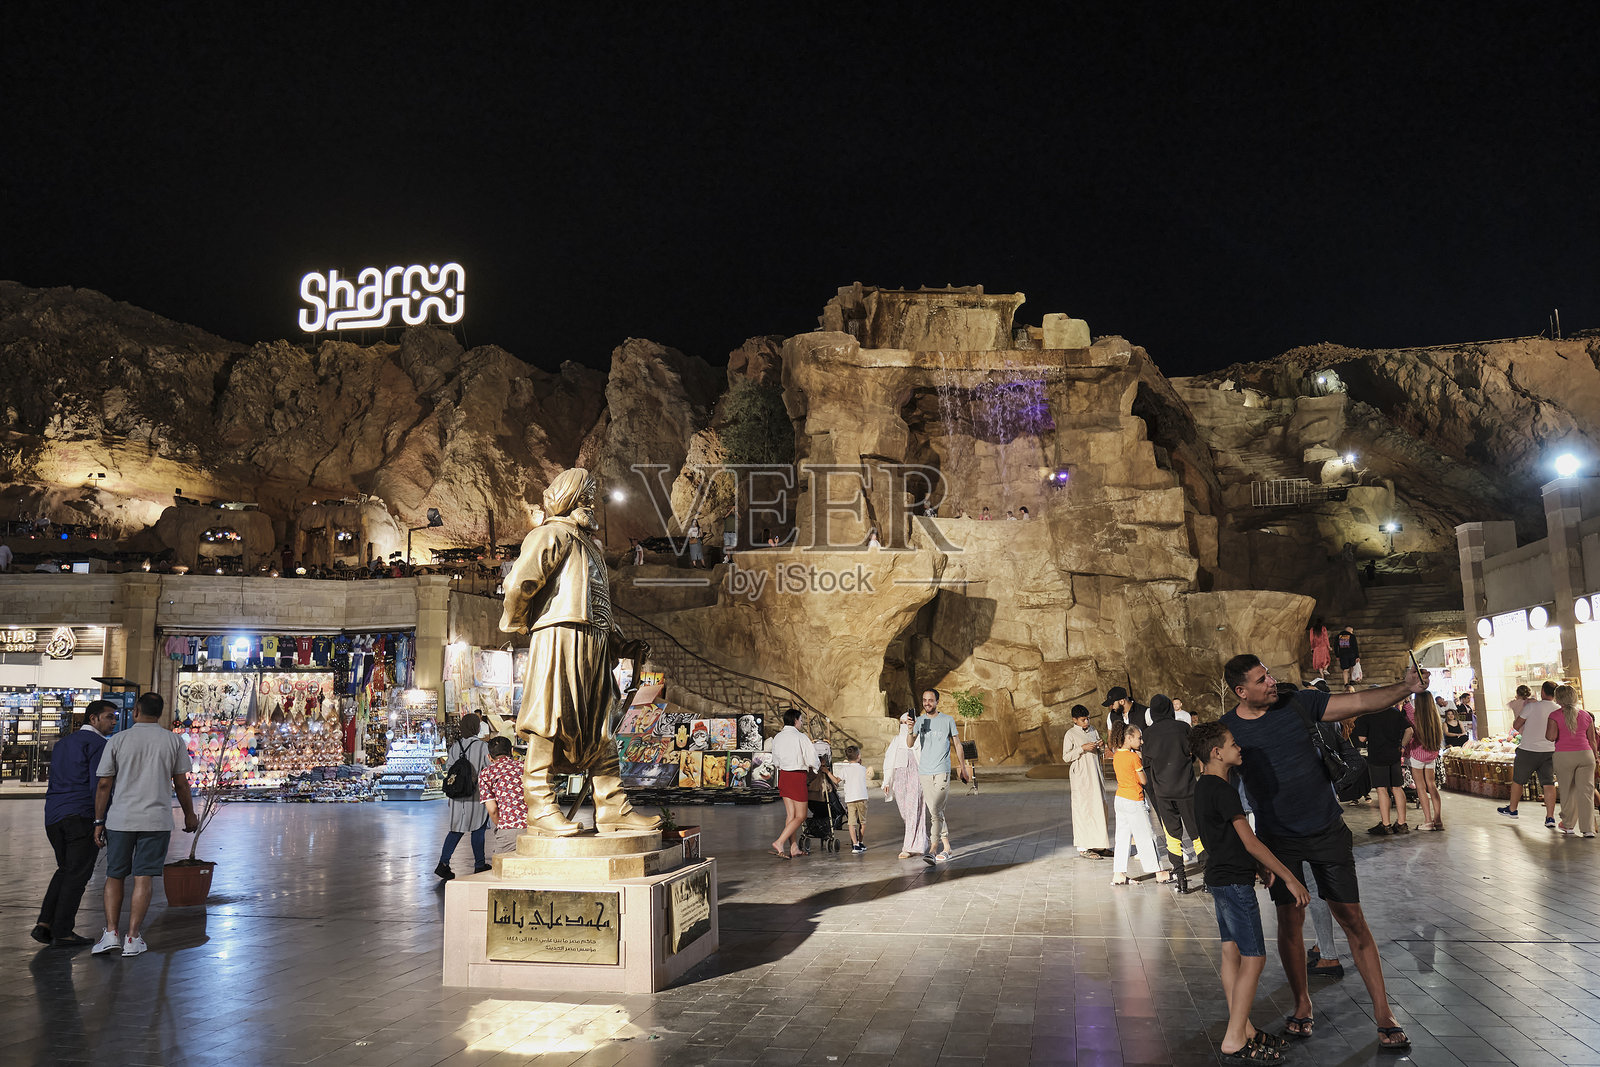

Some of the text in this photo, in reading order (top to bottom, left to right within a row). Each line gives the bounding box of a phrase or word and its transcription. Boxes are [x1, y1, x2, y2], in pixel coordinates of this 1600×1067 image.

[266, 641, 274, 650] 10
[302, 642, 309, 650] 11
[318, 643, 325, 652] 7
[494, 900, 610, 934] محمد علي باشا
